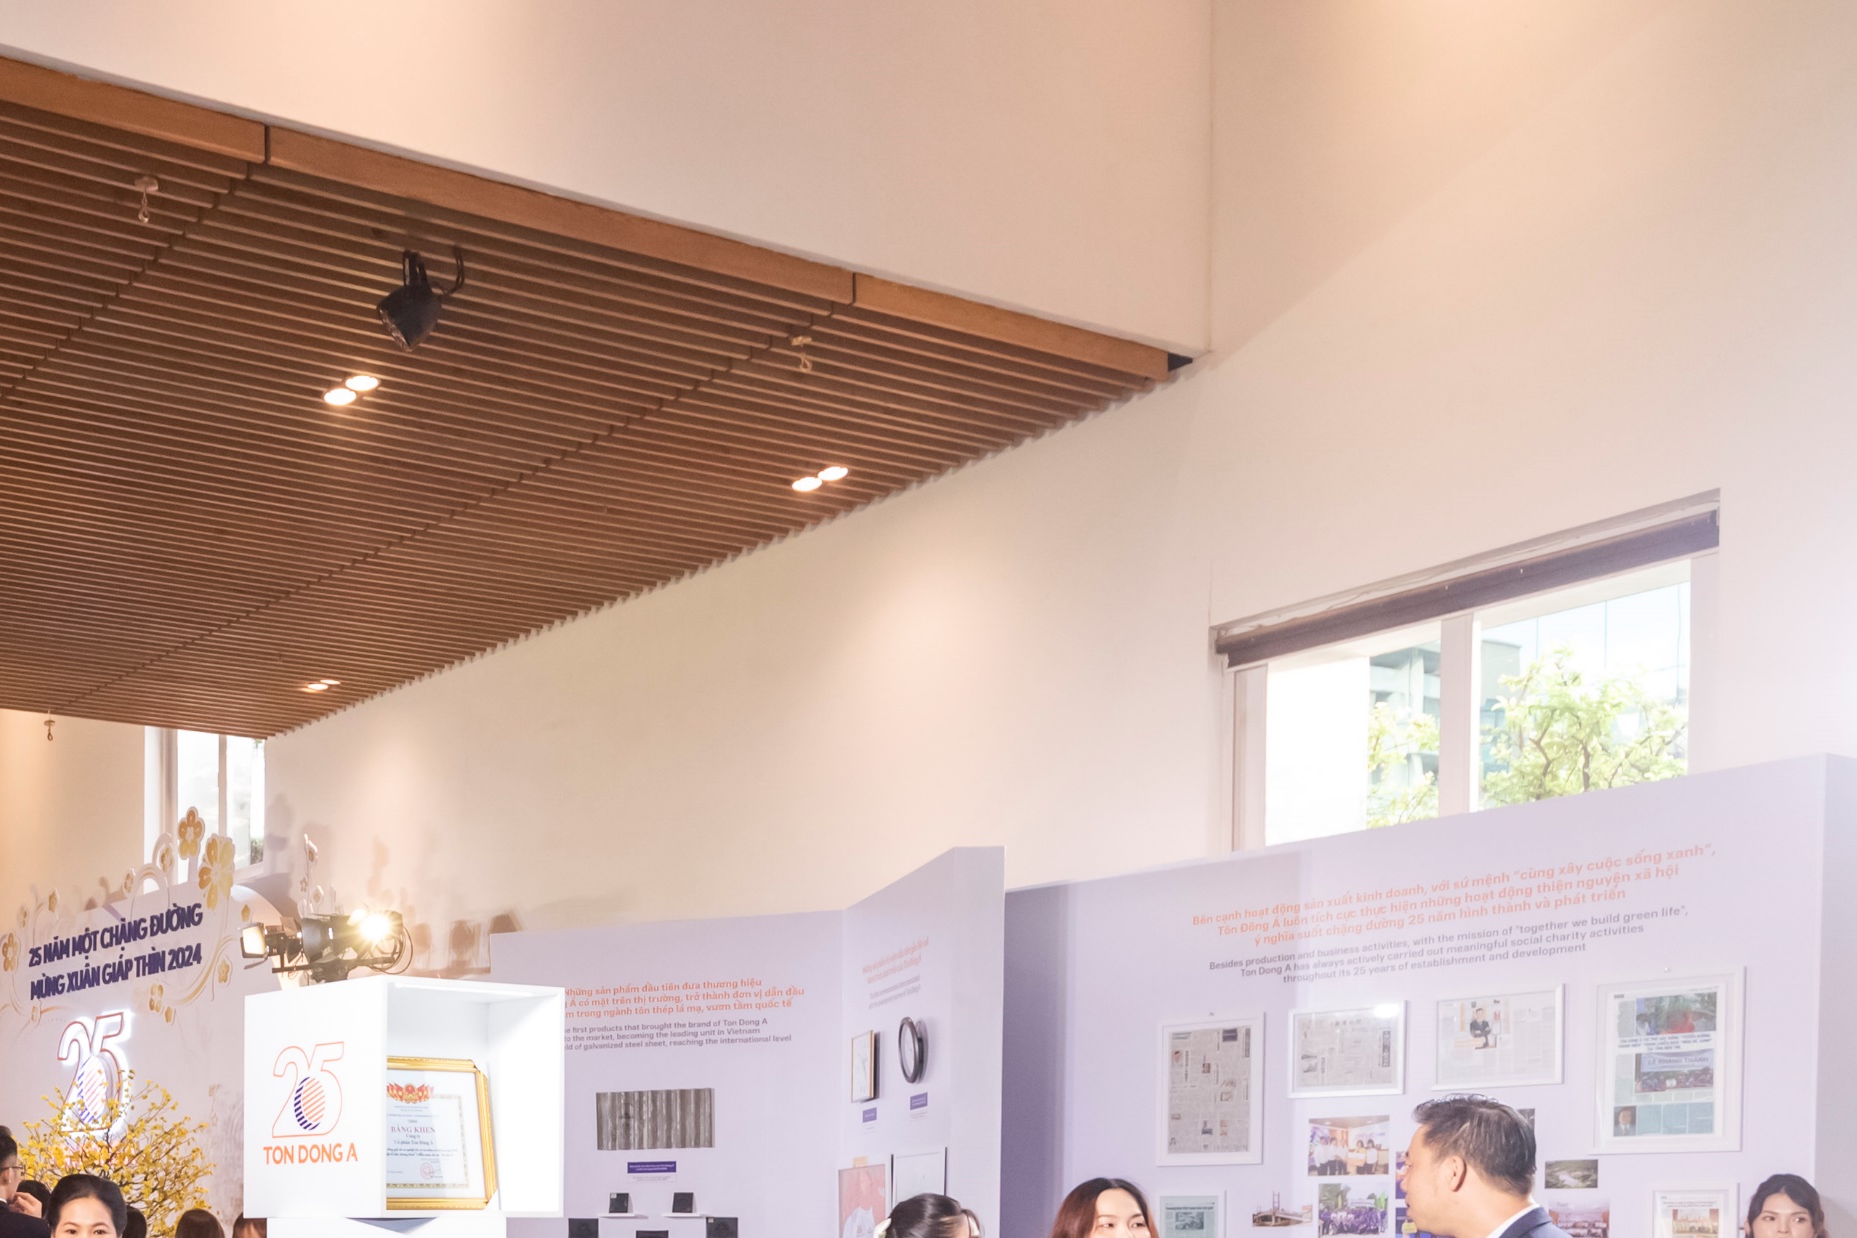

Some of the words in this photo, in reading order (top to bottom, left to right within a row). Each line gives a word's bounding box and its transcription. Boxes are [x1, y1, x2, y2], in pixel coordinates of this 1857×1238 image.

[1357, 891, 1382, 903] kinh
[1408, 915, 1424, 925] 25
[29, 947, 42, 967] 25
[44, 936, 70, 963] NĂM
[72, 927, 99, 959] MỘT
[101, 918, 148, 950] CHẶNG
[150, 903, 203, 937] ĐƯỜNG
[1210, 959, 1243, 970] Besides
[1246, 952, 1295, 968] production
[1298, 950, 1315, 960] and
[1317, 945, 1360, 957] business
[1362, 939, 1410, 952] activities,
[1414, 935, 1435, 945] with
[1438, 933, 1454, 942] the
[1458, 929, 1499, 941] mission
[1502, 926, 1513, 935] of
[1572, 919, 1588, 927] we
[1592, 914, 1620, 925] build
[1623, 908, 1658, 923] green
[1241, 969, 1256, 977] Ton
[1259, 966, 1283, 976] Dong
[1285, 964, 1292, 972] A
[1294, 962, 1310, 971] has
[1313, 959, 1345, 970] always
[1347, 953, 1384, 967] actively
[1388, 949, 1424, 962] carried
[1427, 946, 1443, 955] out
[1447, 941, 1508, 954] meaningful
[1511, 936, 1542, 947] social
[1545, 932, 1587, 944] charity
[1590, 924, 1644, 938] activities
[67, 963, 100, 992] XUÂN
[102, 954, 133, 984] GIÁP
[134, 947, 165, 977] THÌN
[168, 943, 202, 970] 2024
[1284, 971, 1336, 983] throughout
[1339, 970, 1351, 978] its
[1354, 966, 1366, 975] 25
[1369, 964, 1396, 975] years
[1398, 962, 1408, 971] of
[1411, 955, 1486, 970] establishment
[1489, 952, 1509, 961] and
[1512, 944, 1586, 959] development
[577, 1010, 601, 1018] trong
[589, 1025, 622, 1033] products
[642, 1023, 671, 1031] brought
[739, 1019, 760, 1027] Dong
[617, 1032, 654, 1040] becoming
[670, 1030, 698, 1038] leading
[583, 1042, 622, 1051] galvanized
[670, 1038, 703, 1046] reaching
[720, 1036, 770, 1044] international
[272, 1041, 344, 1138] 25
[263, 1145, 294, 1165] TON
[298, 1143, 343, 1164] DONG
[346, 1142, 358, 1162] A
